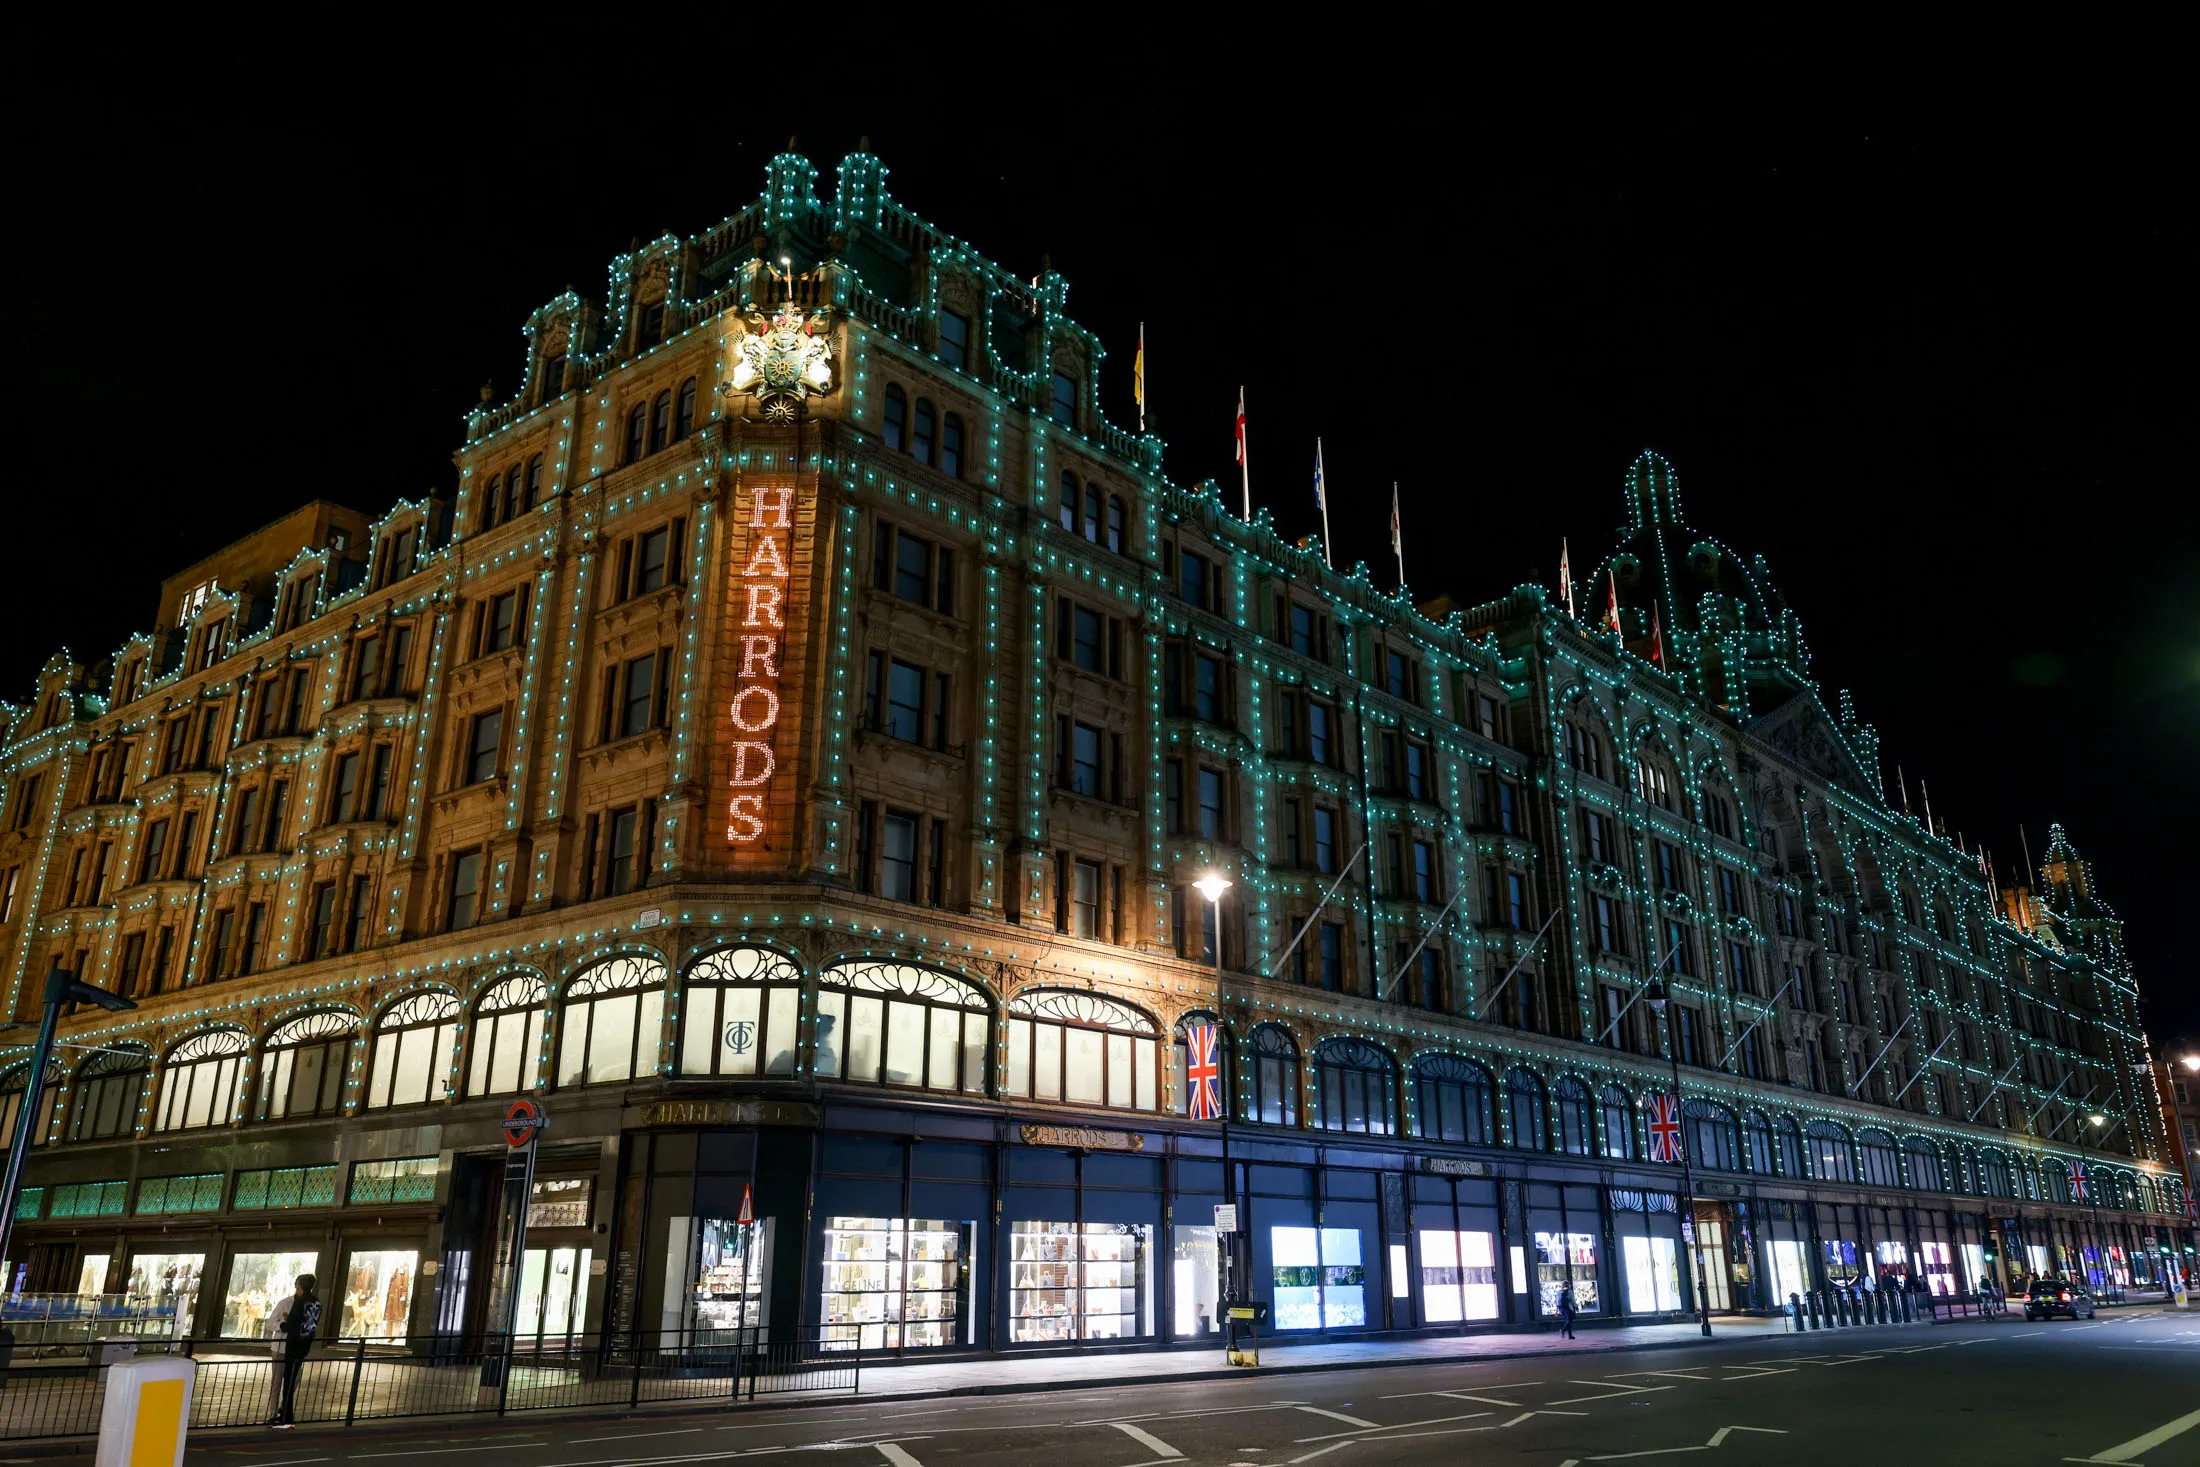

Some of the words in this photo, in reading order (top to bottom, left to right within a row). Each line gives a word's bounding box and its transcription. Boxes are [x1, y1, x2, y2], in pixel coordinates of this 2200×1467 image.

[727, 487, 794, 841] HARRODS
[502, 1119, 537, 1128] UNDERGROUND
[1041, 1126, 1107, 1146] HARRODS
[843, 1280, 882, 1291] CELINE
